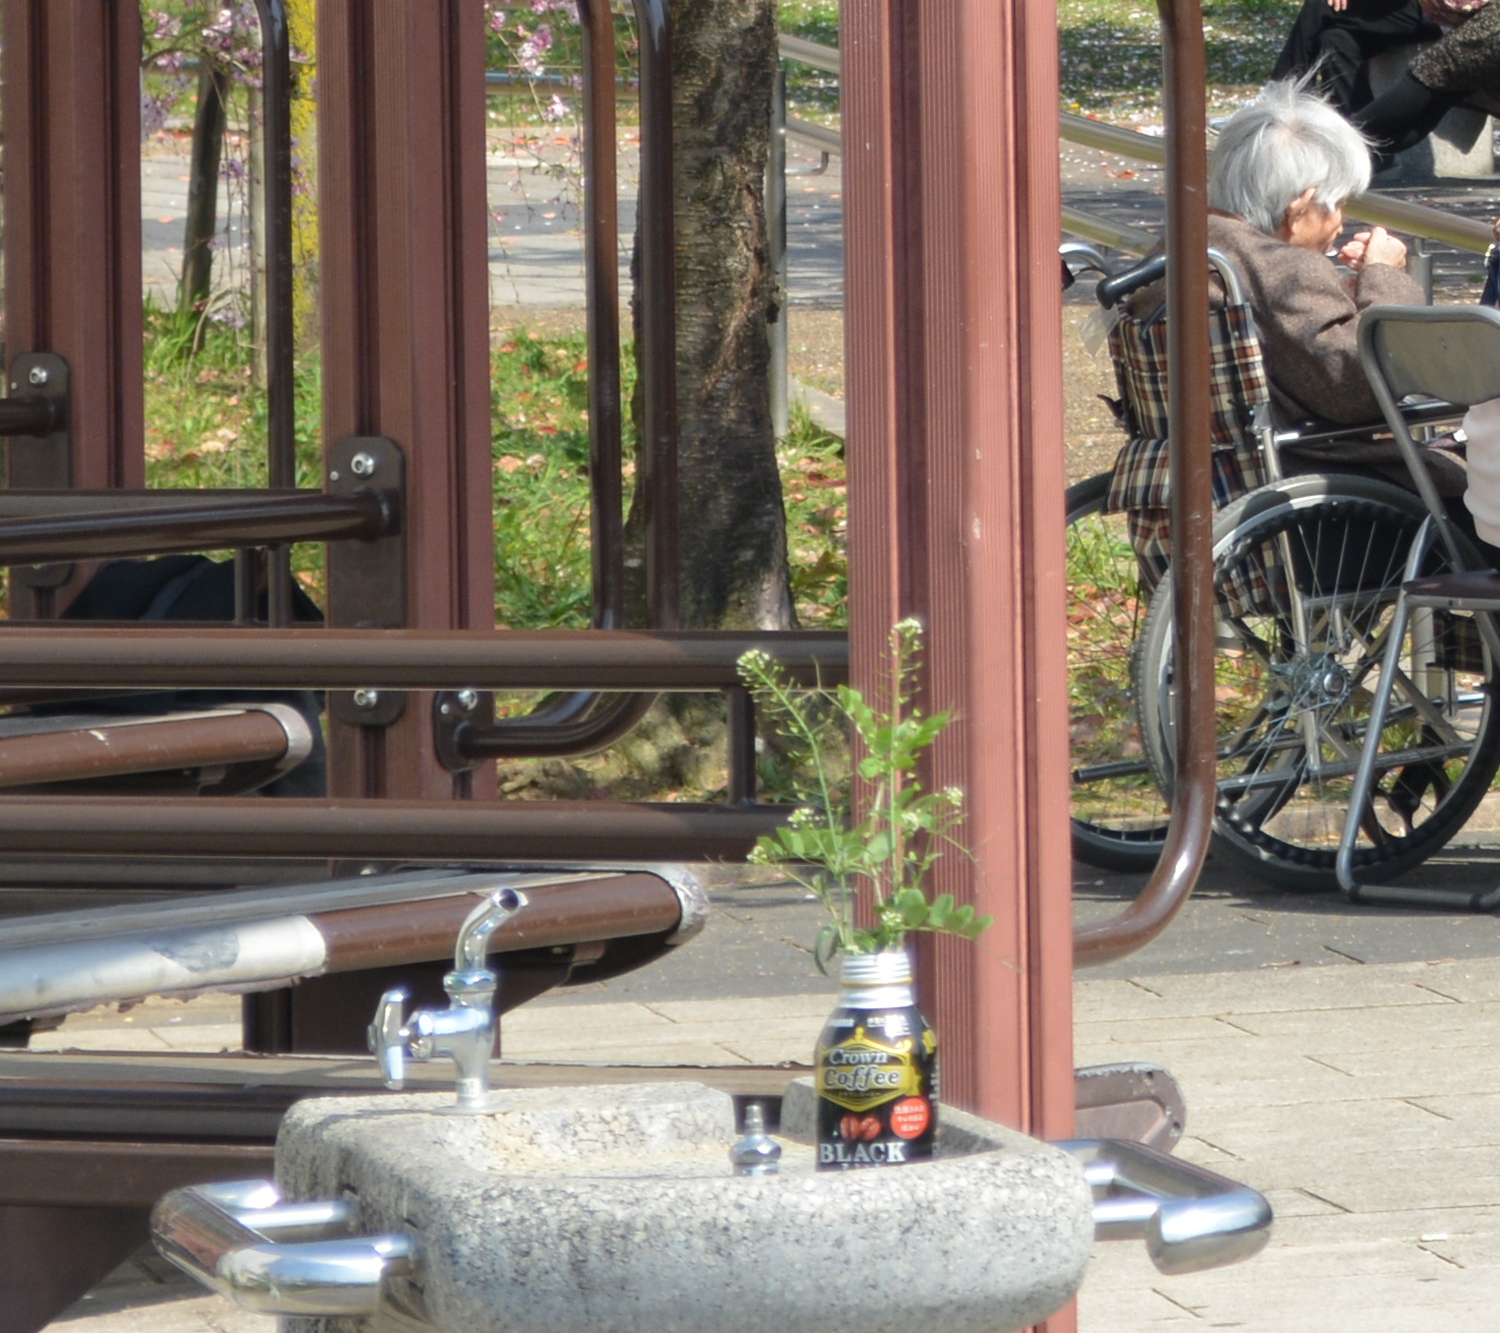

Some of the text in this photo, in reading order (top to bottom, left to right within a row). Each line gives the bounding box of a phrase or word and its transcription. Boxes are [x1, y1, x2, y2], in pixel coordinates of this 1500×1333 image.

[829, 1048, 888, 1064] Crown
[823, 1064, 901, 1091] Coffee
[819, 1142, 906, 1163] BLACK
